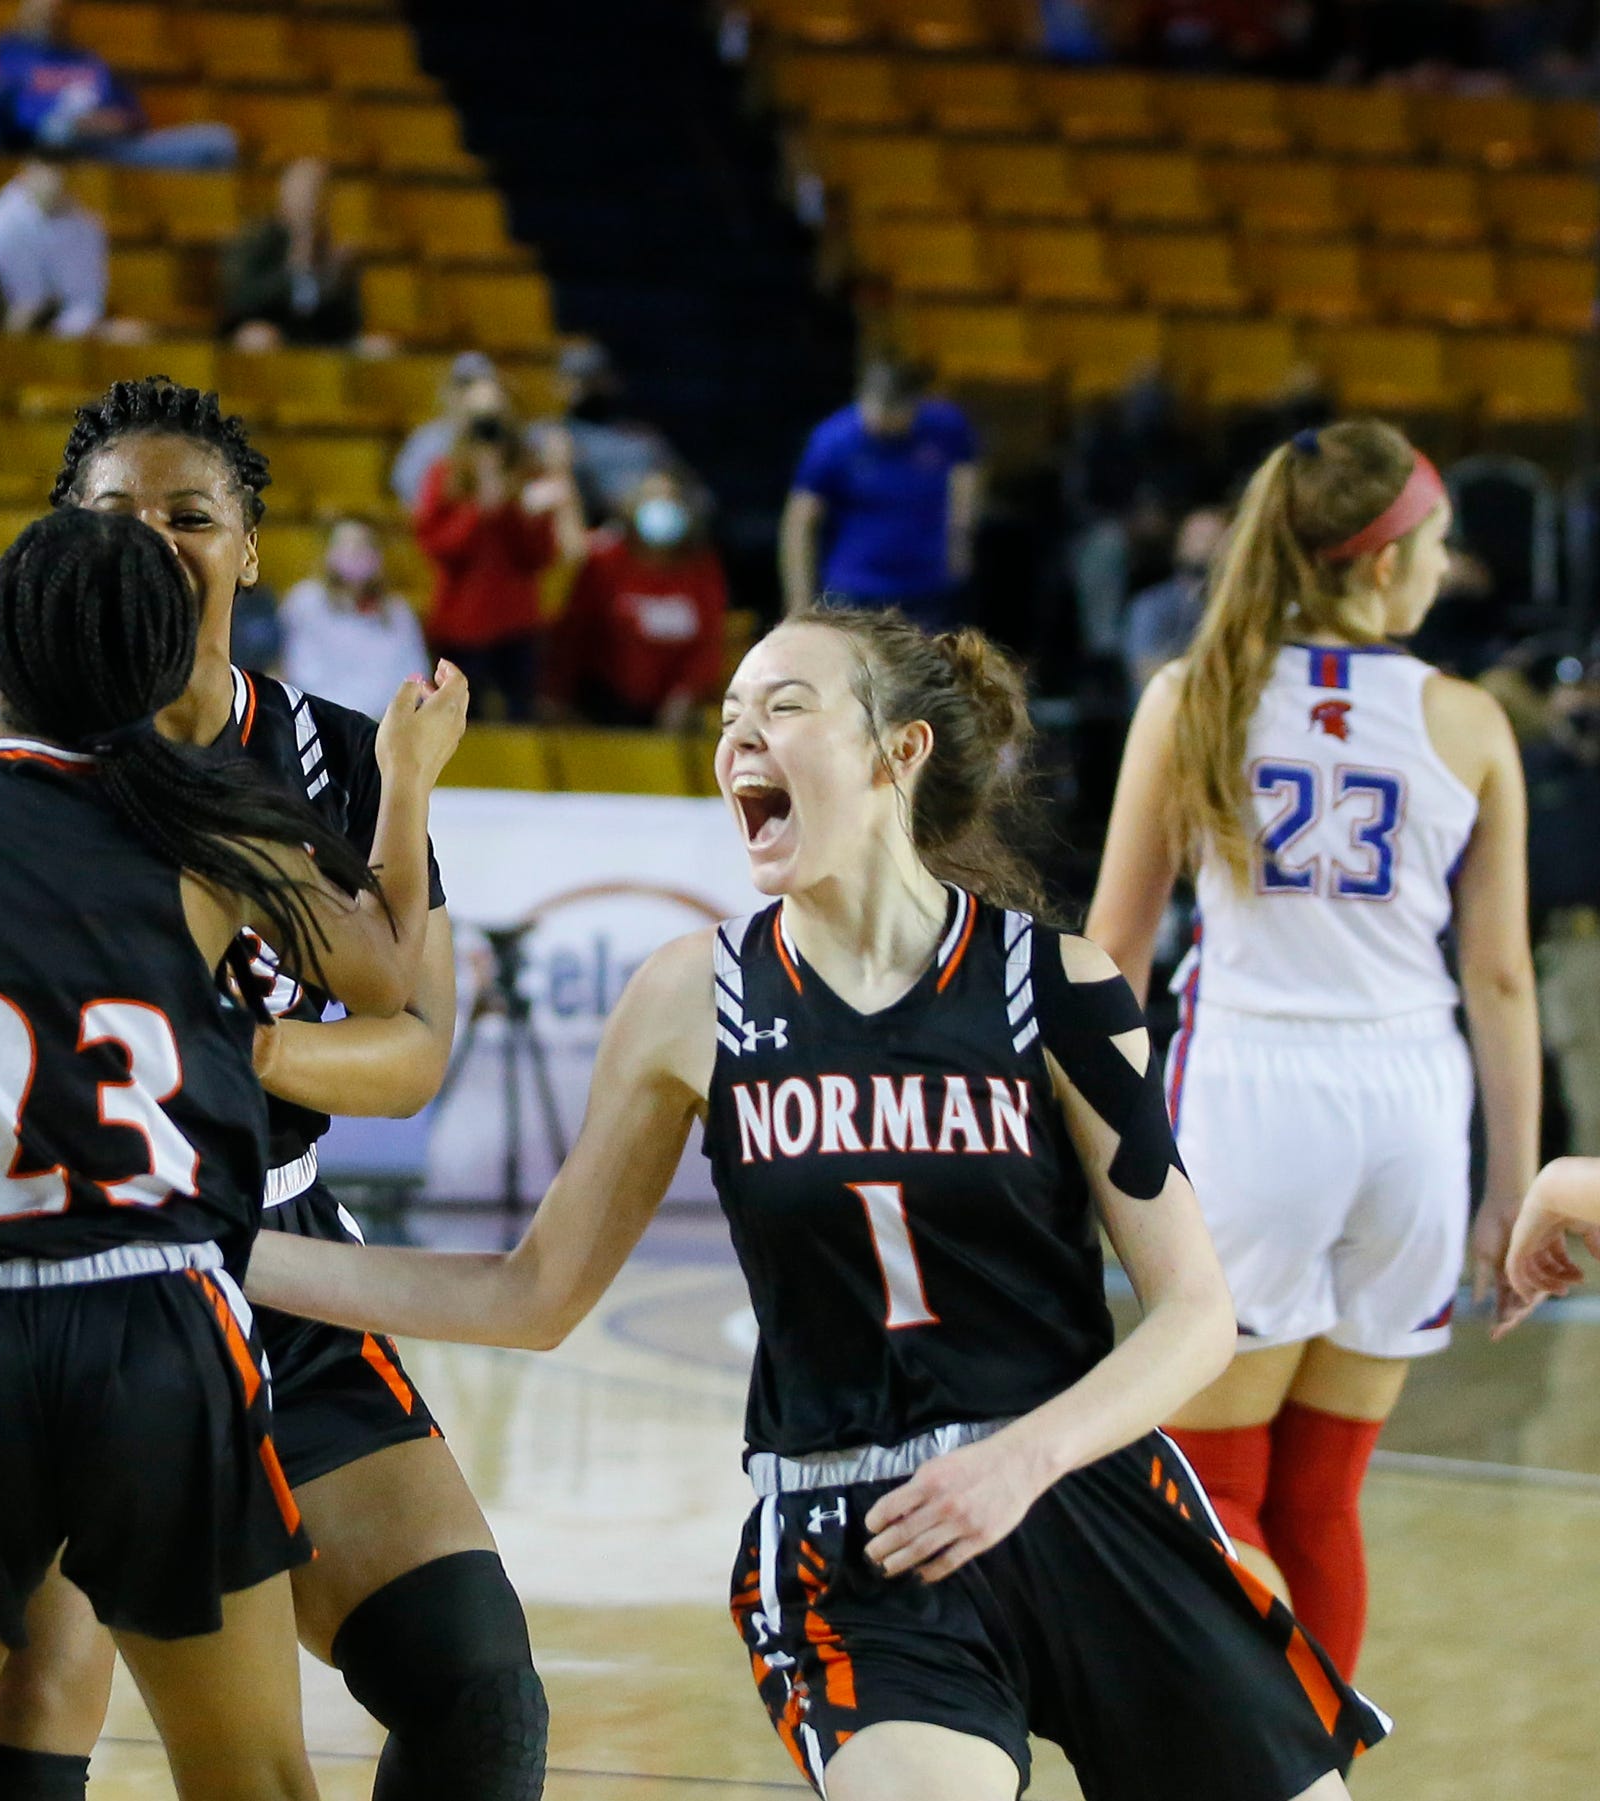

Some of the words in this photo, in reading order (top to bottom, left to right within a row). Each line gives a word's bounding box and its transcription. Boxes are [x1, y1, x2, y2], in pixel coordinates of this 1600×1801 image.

[1250, 756, 1408, 903] 23
[732, 1074, 1032, 1164] NORMAN
[844, 1181, 941, 1329] 1
